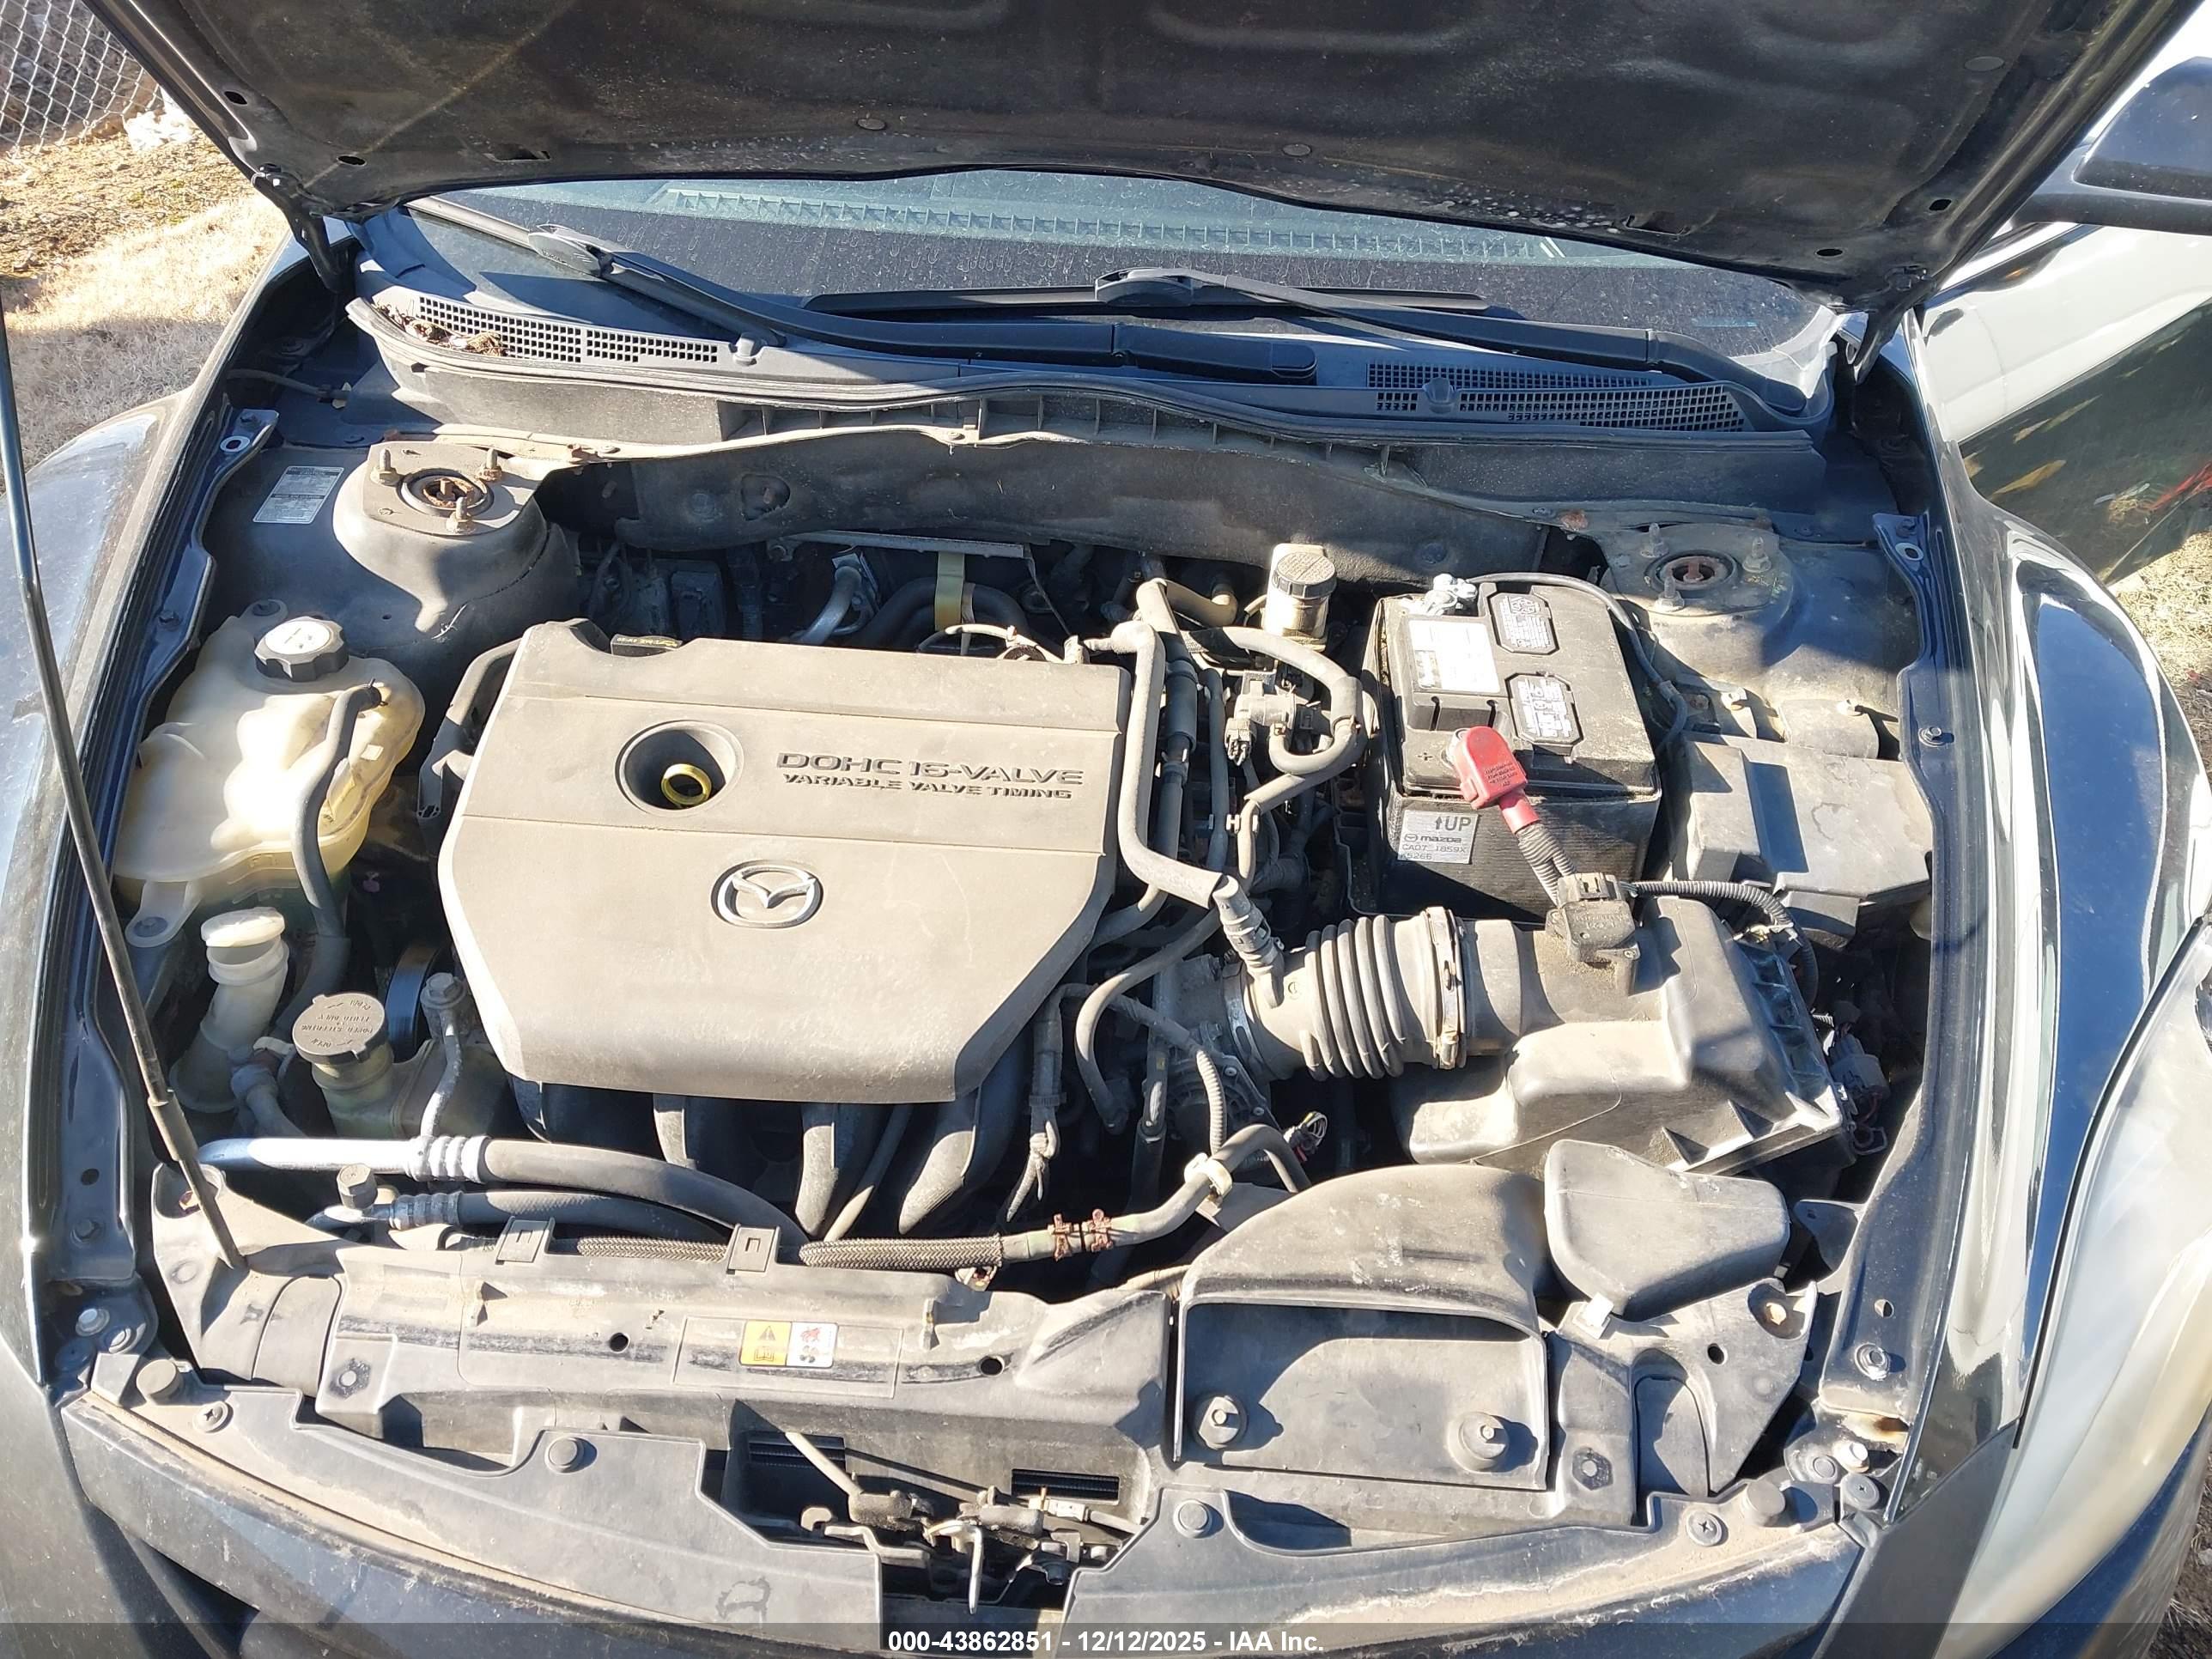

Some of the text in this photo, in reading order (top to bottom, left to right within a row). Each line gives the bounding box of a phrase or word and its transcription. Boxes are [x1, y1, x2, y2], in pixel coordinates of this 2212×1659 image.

[776, 752, 1084, 785] DOHC 16-VALVE
[783, 773, 1072, 799] VARIABLE VALVE TIMING
[1445, 816, 1471, 831] UP
